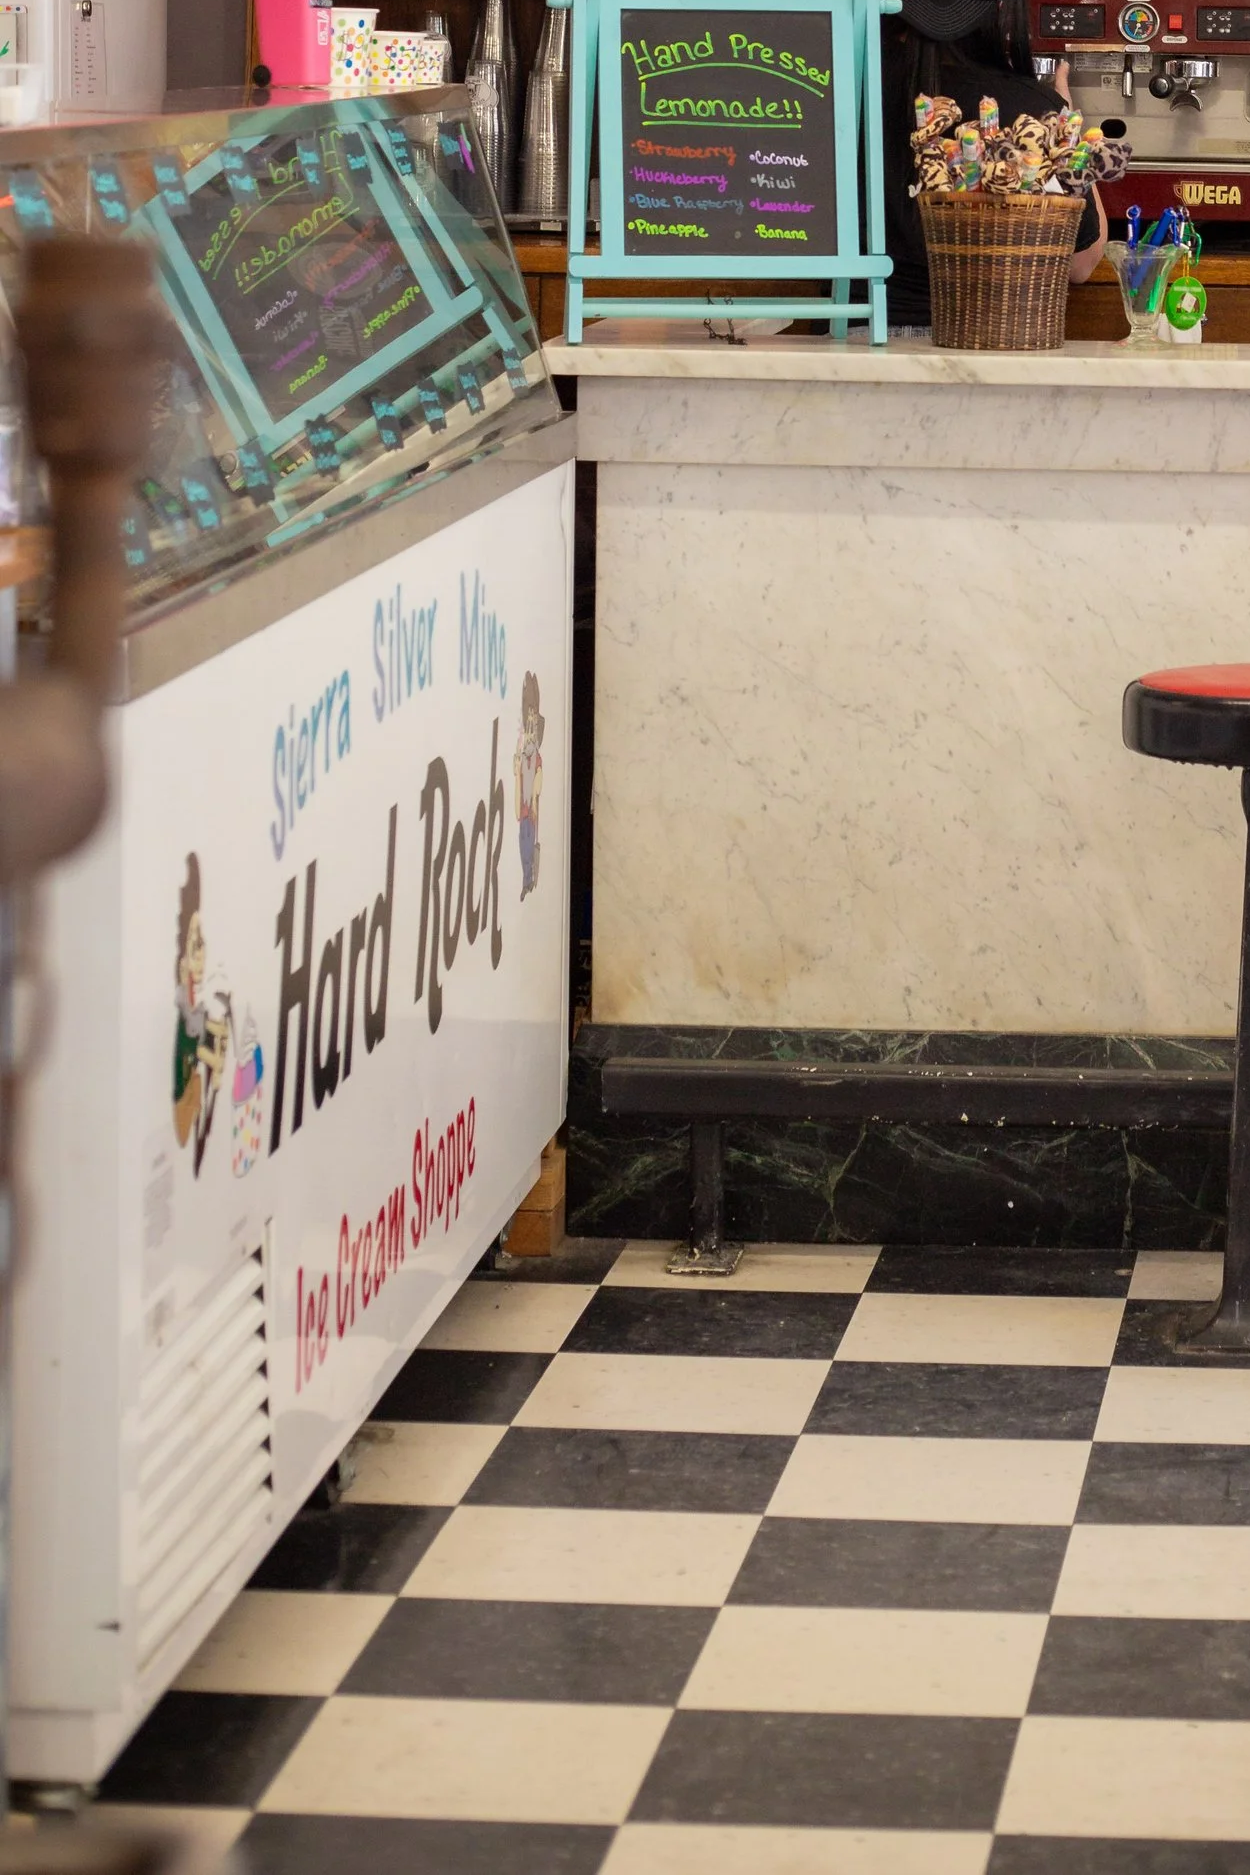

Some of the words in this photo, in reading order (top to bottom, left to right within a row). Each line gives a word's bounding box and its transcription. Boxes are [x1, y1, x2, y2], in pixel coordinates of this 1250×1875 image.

[621, 31, 714, 75] Hand
[728, 33, 831, 86] Pressed
[640, 82, 804, 120] Lemonade!!
[636, 138, 737, 166] Strawberry
[756, 173, 796, 190] Kiwi
[1182, 181, 1242, 205] WEGA
[635, 193, 671, 208] Blue
[635, 218, 710, 239] Pineapple
[756, 223, 808, 241] Banana
[270, 669, 350, 862] Sierra
[372, 582, 437, 724] Silver
[459, 568, 507, 700] Mine
[267, 802, 398, 1158] Hard
[414, 716, 504, 1036] Rock
[296, 1264, 329, 1395] Ice
[336, 1183, 405, 1341] Cream
[410, 1095, 476, 1251] Shoppe
